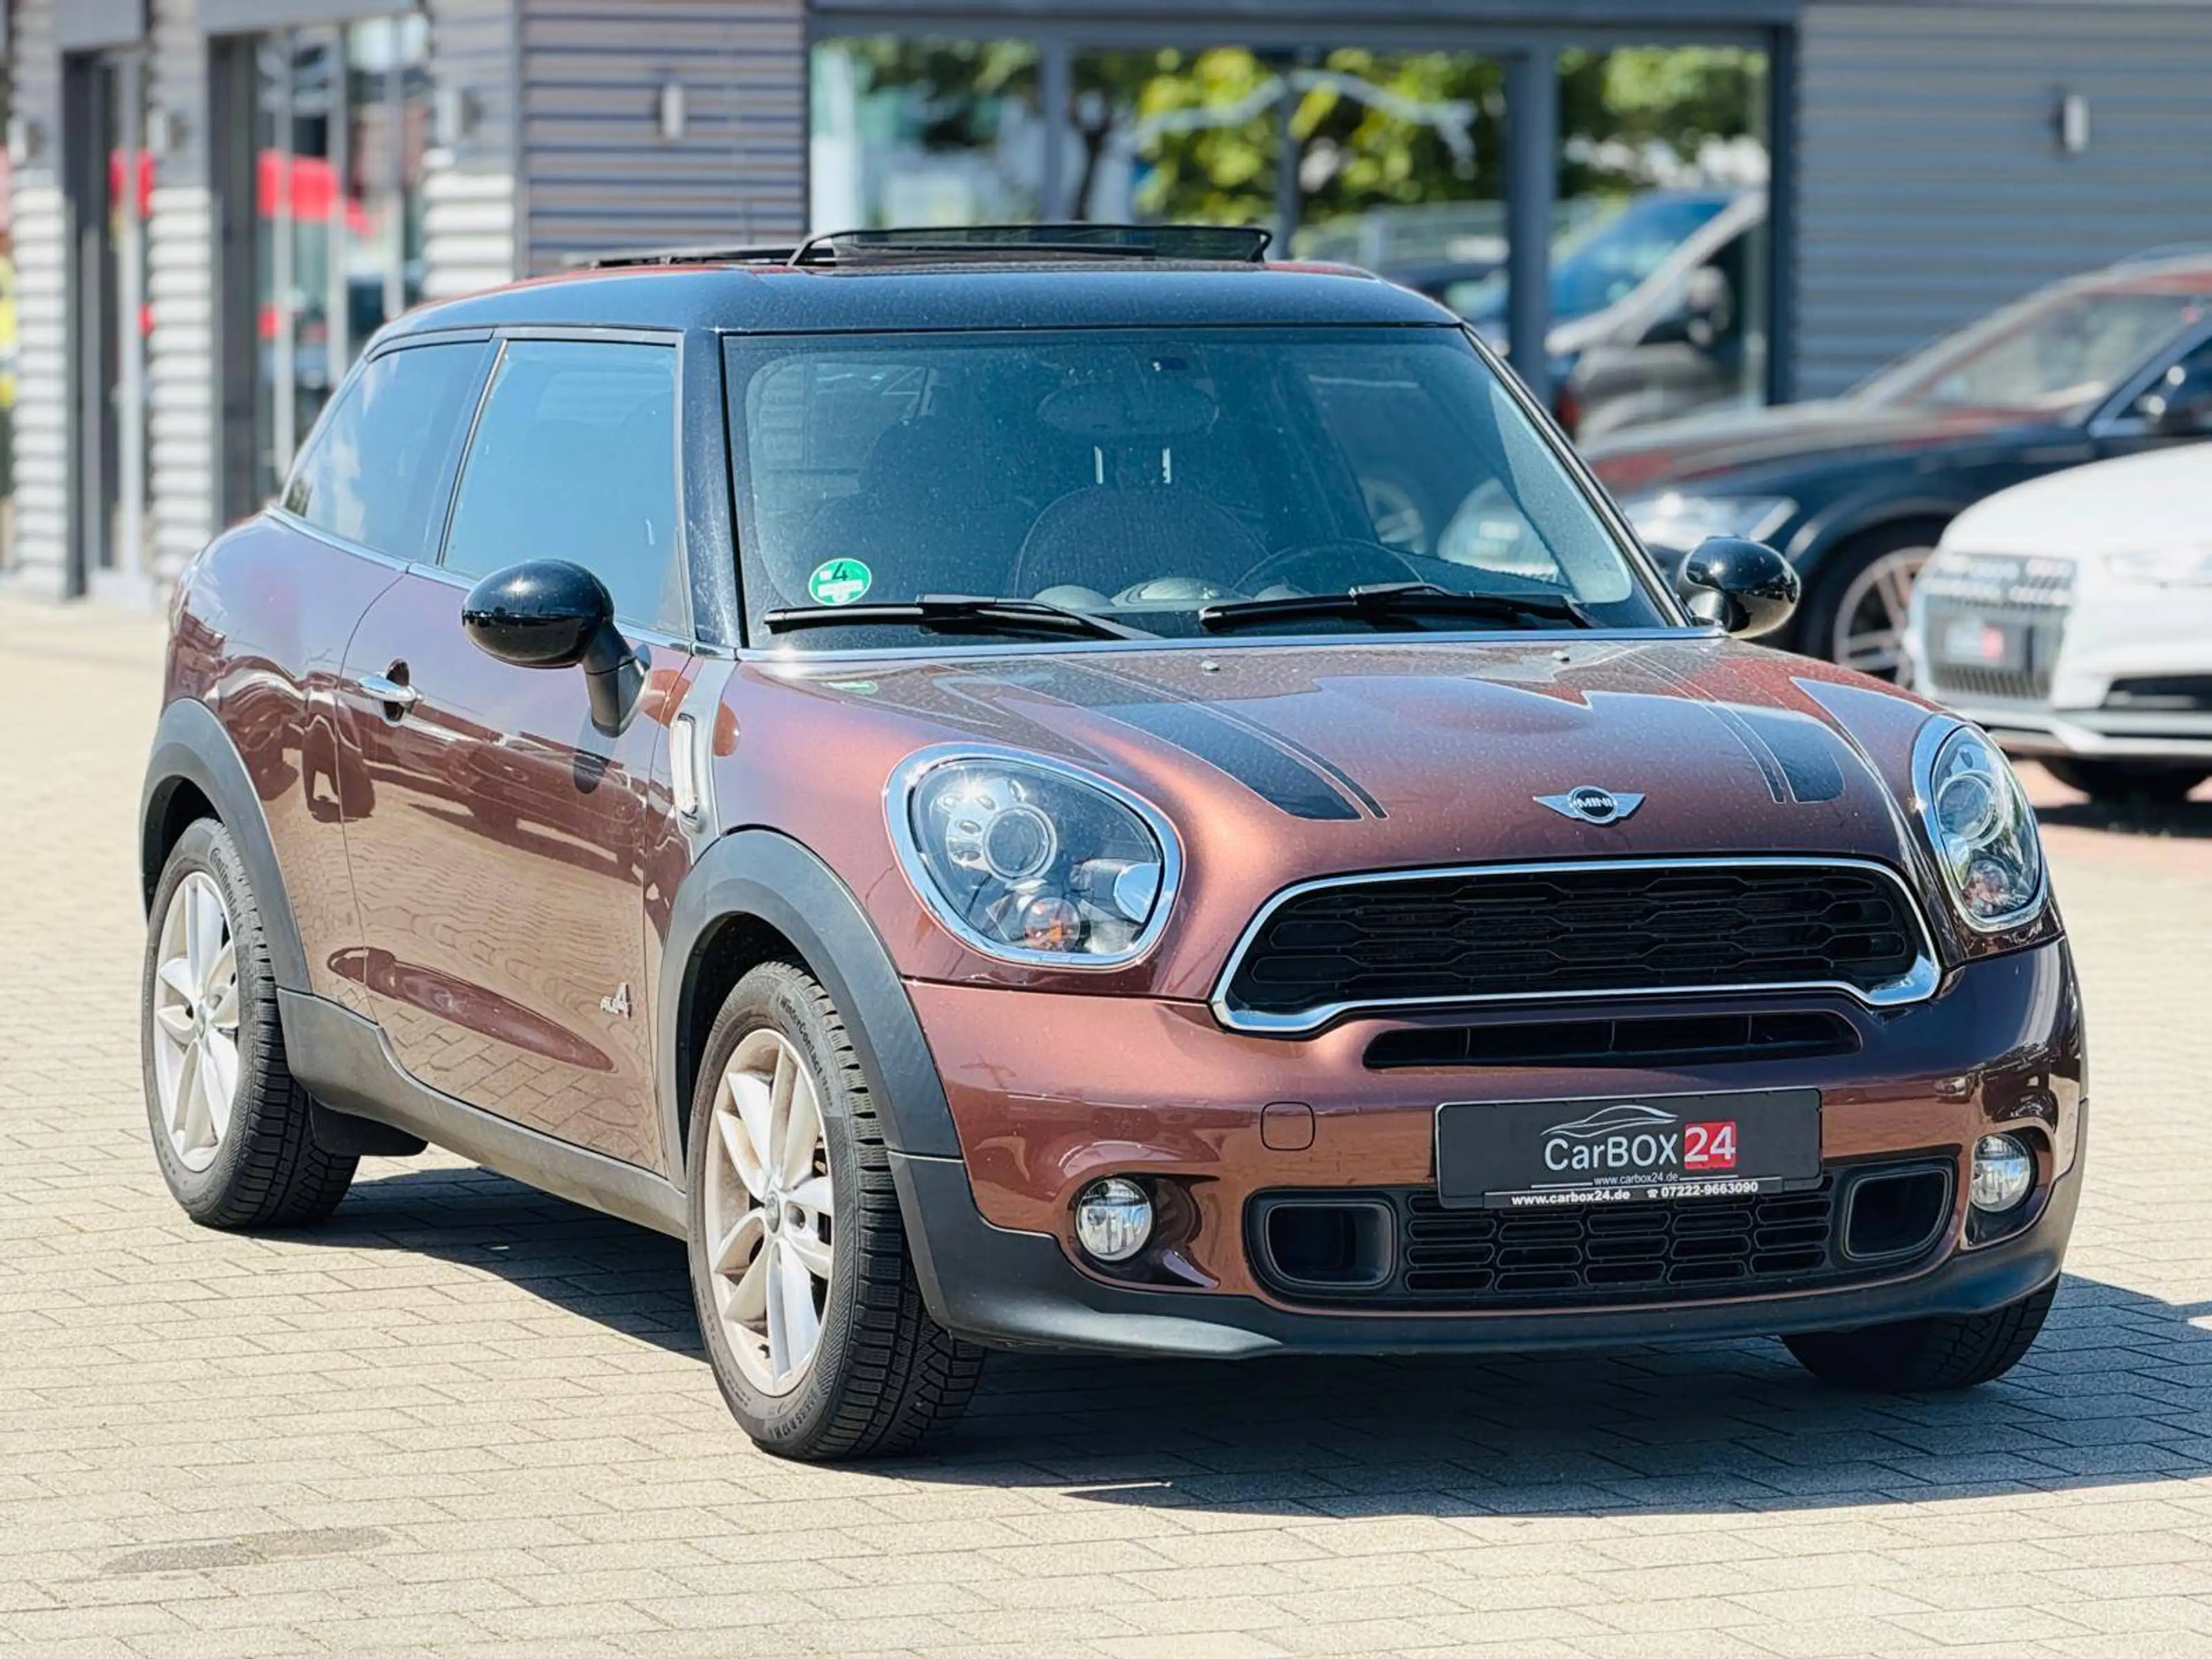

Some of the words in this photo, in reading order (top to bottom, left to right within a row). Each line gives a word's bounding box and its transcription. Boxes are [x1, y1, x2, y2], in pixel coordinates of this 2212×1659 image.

[832, 562, 849, 581] 4
[1575, 797, 1614, 807] MINI
[1544, 1132, 1678, 1171] CarBOX
[1684, 1126, 1736, 1162] 24
[1593, 1171, 1680, 1185] www.carbox24.de
[1511, 1188, 1631, 1206] www.carbox24.de
